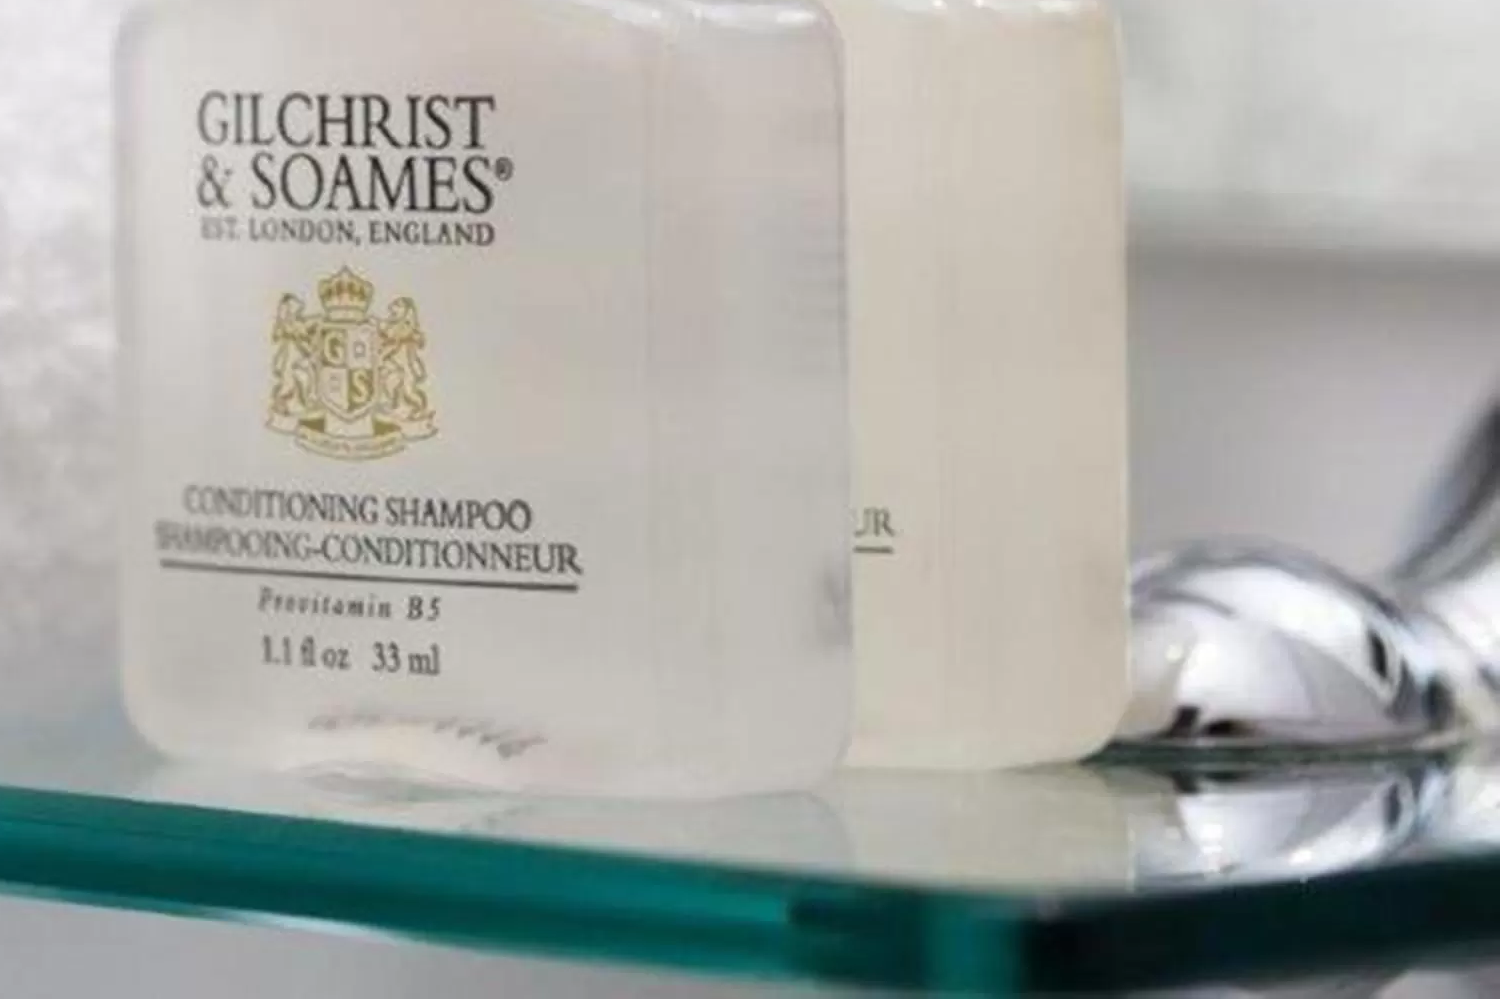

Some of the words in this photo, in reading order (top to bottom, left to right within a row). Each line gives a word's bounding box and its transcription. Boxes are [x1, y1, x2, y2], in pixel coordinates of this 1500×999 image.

[197, 90, 497, 149] GILCHRIST
[197, 154, 233, 208] &
[249, 217, 362, 246] LONDON,
[369, 220, 496, 247] ENGLAND
[183, 485, 379, 525] CONDITIONING
[385, 497, 533, 533] SHAMPOO
[258, 586, 392, 618] Provitamin
[407, 595, 442, 622] B5
[262, 635, 293, 665] 1.1
[301, 635, 317, 666] fl
[322, 646, 350, 669] oz
[372, 641, 401, 673] 33
[408, 643, 442, 676] ml
